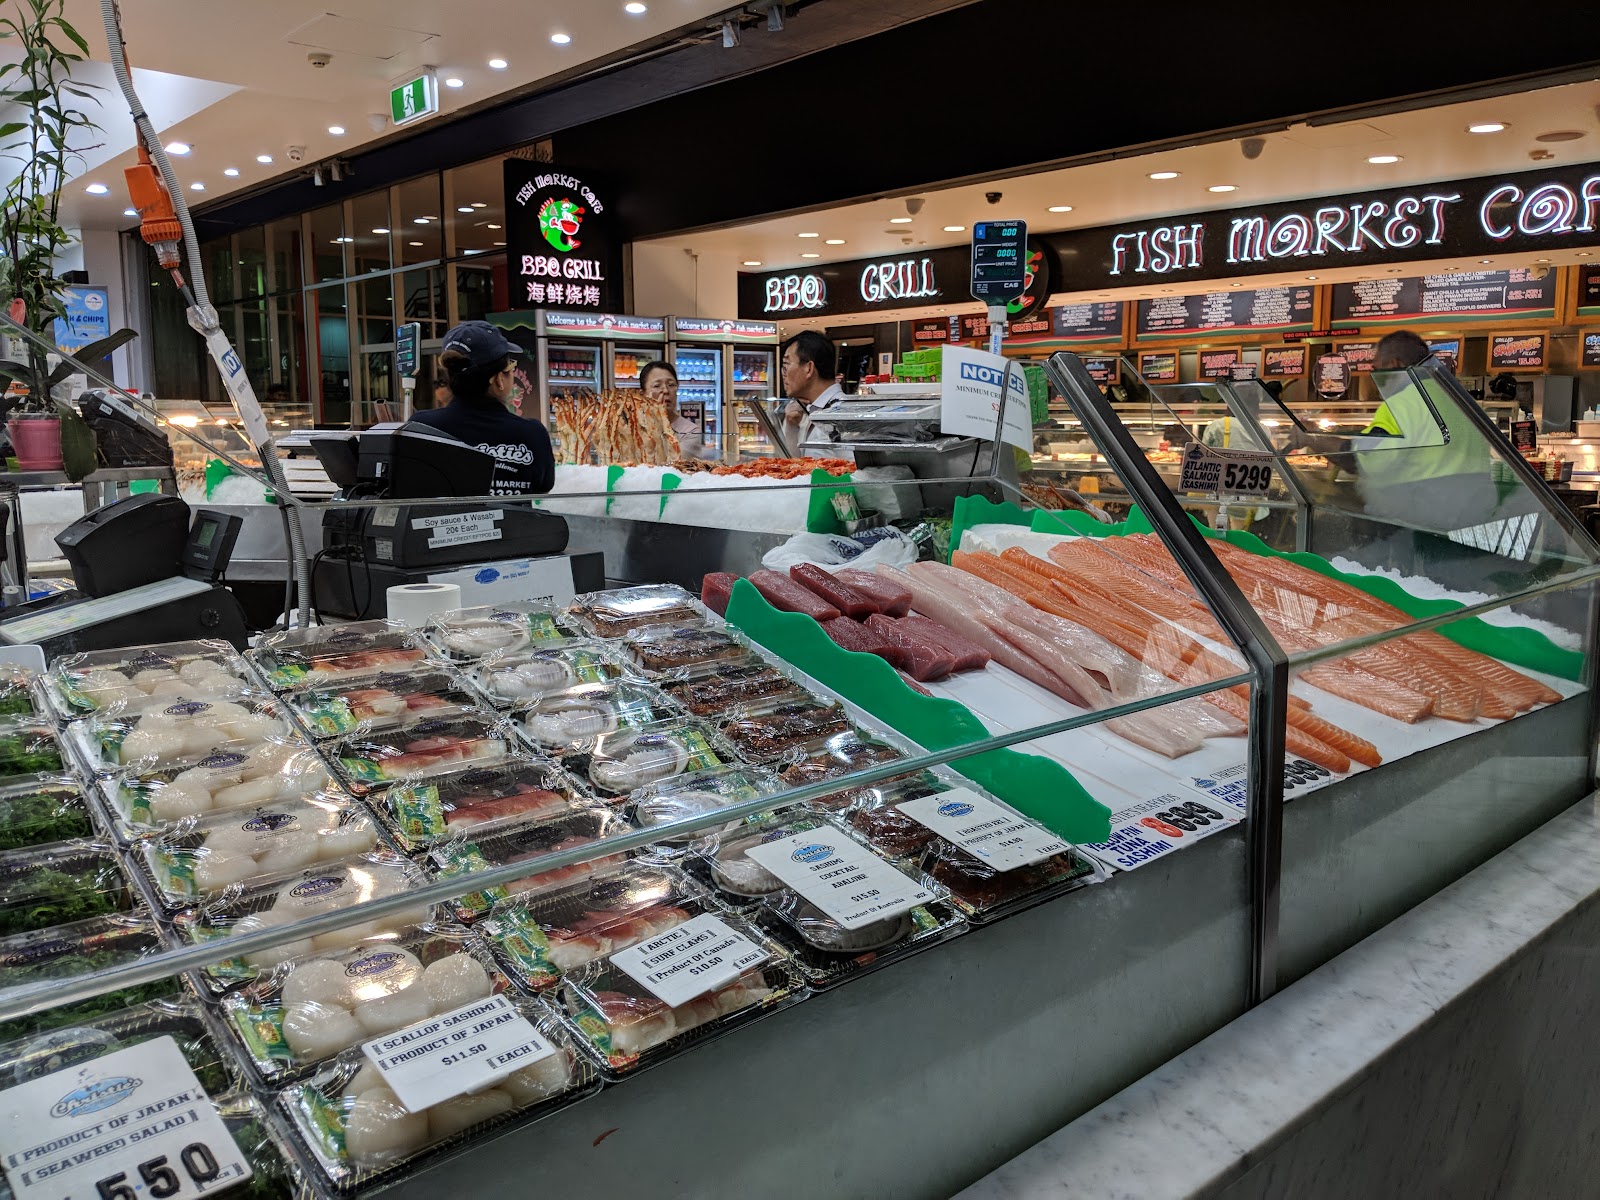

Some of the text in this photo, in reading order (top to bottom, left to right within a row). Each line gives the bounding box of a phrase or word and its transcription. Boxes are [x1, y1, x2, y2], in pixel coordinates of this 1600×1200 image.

[516, 173, 603, 214] FISH MARKET CAFE
[1109, 223, 1205, 275] FISH
[1227, 193, 1461, 263] MARKET
[520, 255, 605, 280] BBQ GRILL
[527, 282, 601, 306] 海鲜烧烤
[764, 258, 938, 312] BBQ GRILL
[82, 315, 105, 323] CHIPS
[546, 314, 576, 325] Welcome
[577, 317, 585, 326] to
[586, 318, 597, 326] the
[618, 320, 629, 328] fish
[630, 321, 650, 330] market
[650, 322, 664, 330] cafe
[676, 321, 701, 330] Welcome
[709, 323, 718, 331] the
[746, 325, 764, 333] market
[764, 326, 776, 334] cafe
[1012, 321, 1049, 333] ORDER HERE
[916, 330, 946, 339] ORDER HERE
[956, 385, 989, 396] MINIMUM
[1184, 461, 1221, 472] ATLANTIC
[495, 480, 532, 489] MARKET
[1183, 471, 1219, 481] SALMON
[1181, 480, 1218, 491] (SASHIMI)
[425, 517, 440, 528] Soy
[440, 516, 462, 526] sauce
[470, 511, 496, 522] Wasabi
[445, 523, 479, 535] 20¢ Each
[429, 538, 453, 547] MINIMUM
[964, 824, 1026, 847] PRODUCT OF JAPAN
[1120, 825, 1143, 837] FIN
[1110, 837, 1150, 855] TUNA
[1117, 839, 1174, 867] SASHIMI
[809, 857, 845, 872] SASHIMI
[819, 864, 860, 881] COCKTAIL
[831, 873, 869, 890] ABALONE
[845, 909, 870, 922] Product
[869, 906, 877, 914] Of
[877, 897, 906, 910] Australia
[647, 931, 683, 951] ARCTIC
[650, 934, 709, 965] SURF CLAMS
[655, 938, 737, 980] Product Of Canada
[689, 956, 725, 977] $10.50
[739, 953, 760, 965] EACH
[383, 1002, 497, 1050] SCALLOP SASHIMI
[390, 1012, 514, 1066] PRODUCT OF JAPAN
[441, 1043, 487, 1067] $11.50
[498, 1044, 532, 1064] EACH
[23, 1092, 191, 1162] PRODUCT OF JAPAN
[36, 1115, 187, 1180] SEAWEED SALAD
